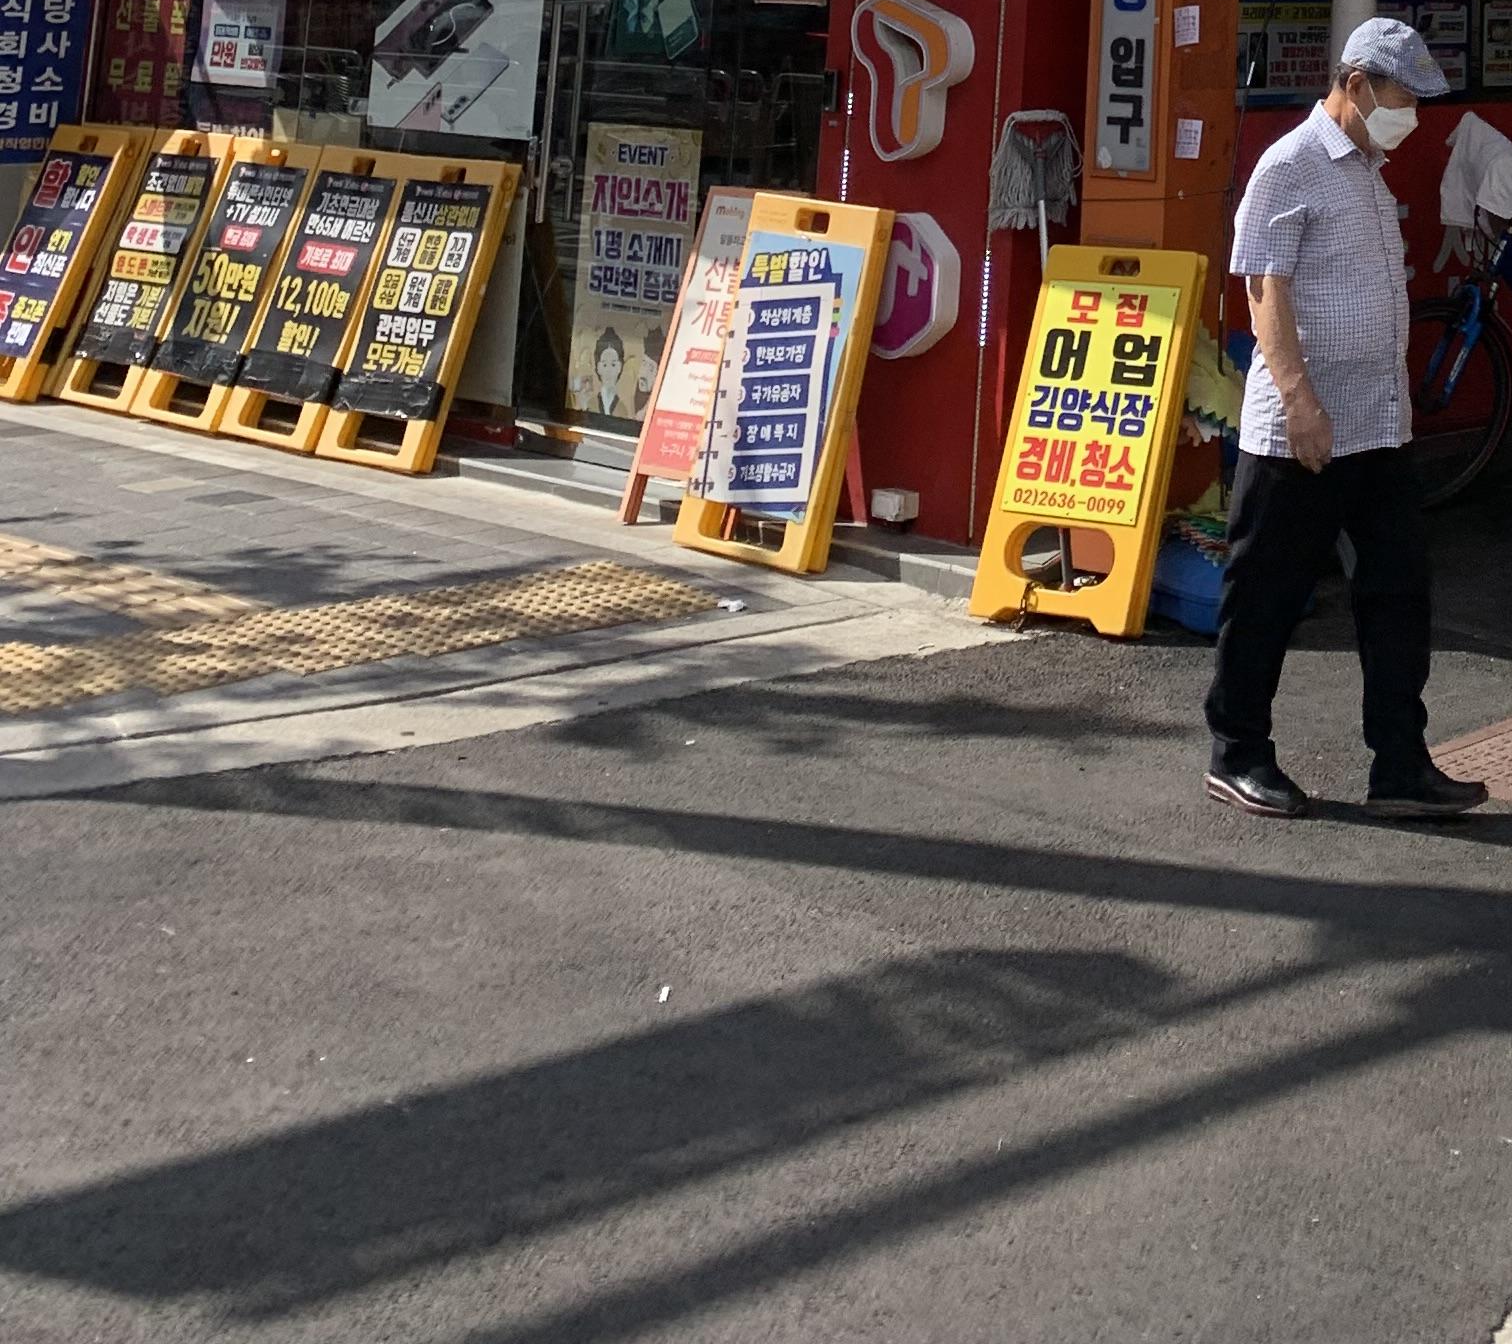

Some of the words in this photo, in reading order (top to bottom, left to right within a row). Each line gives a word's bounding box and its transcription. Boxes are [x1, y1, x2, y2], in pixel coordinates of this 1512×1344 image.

[210, 41, 238, 69] 만원
[1105, 36, 1146, 145] 입구
[618, 143, 668, 166] EVENT
[317, 191, 380, 220] 기초연금대상
[592, 175, 689, 221] 지인소개
[341, 220, 376, 243] 어르신
[594, 229, 623, 260] 1명
[627, 233, 682, 267] 소개시
[193, 252, 262, 302] 50만원
[590, 264, 638, 298] 5만원
[643, 270, 680, 304] 증정
[751, 247, 827, 284] 특별할인
[276, 275, 351, 319] 12,100원
[1067, 289, 1148, 328] 모집
[181, 299, 241, 344] 지원!
[276, 320, 321, 358] 할인!
[375, 314, 437, 348] 관련업무
[362, 342, 432, 378] 모두가능!
[756, 345, 807, 365] 한부모가정
[1040, 327, 1161, 387] 어업
[751, 384, 801, 404] 국가유공자
[1027, 385, 1153, 437] 김양식장
[1013, 488, 1126, 515] 02)2636-0099
